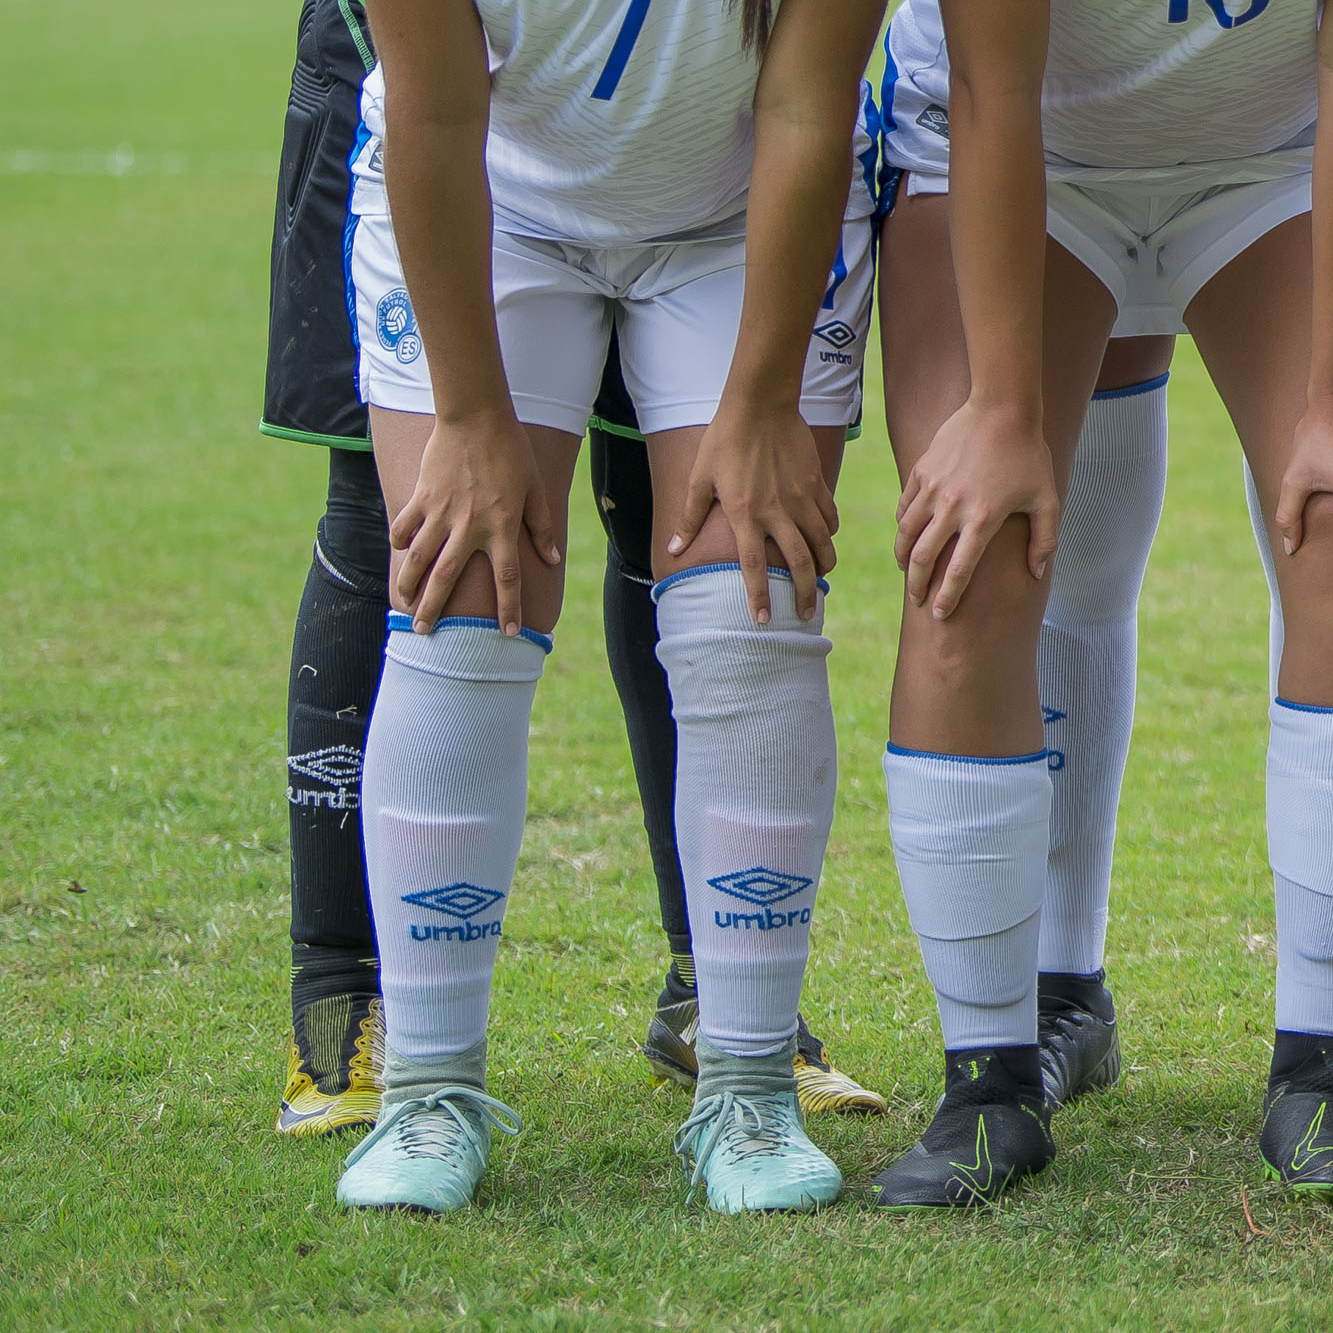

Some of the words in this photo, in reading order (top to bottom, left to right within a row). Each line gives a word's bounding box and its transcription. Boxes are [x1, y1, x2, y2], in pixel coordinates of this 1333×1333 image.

[402, 341, 416, 355] ES
[820, 351, 852, 365] umbro
[287, 786, 360, 809] umb
[714, 909, 810, 930] umbro
[411, 923, 502, 942] umbro
